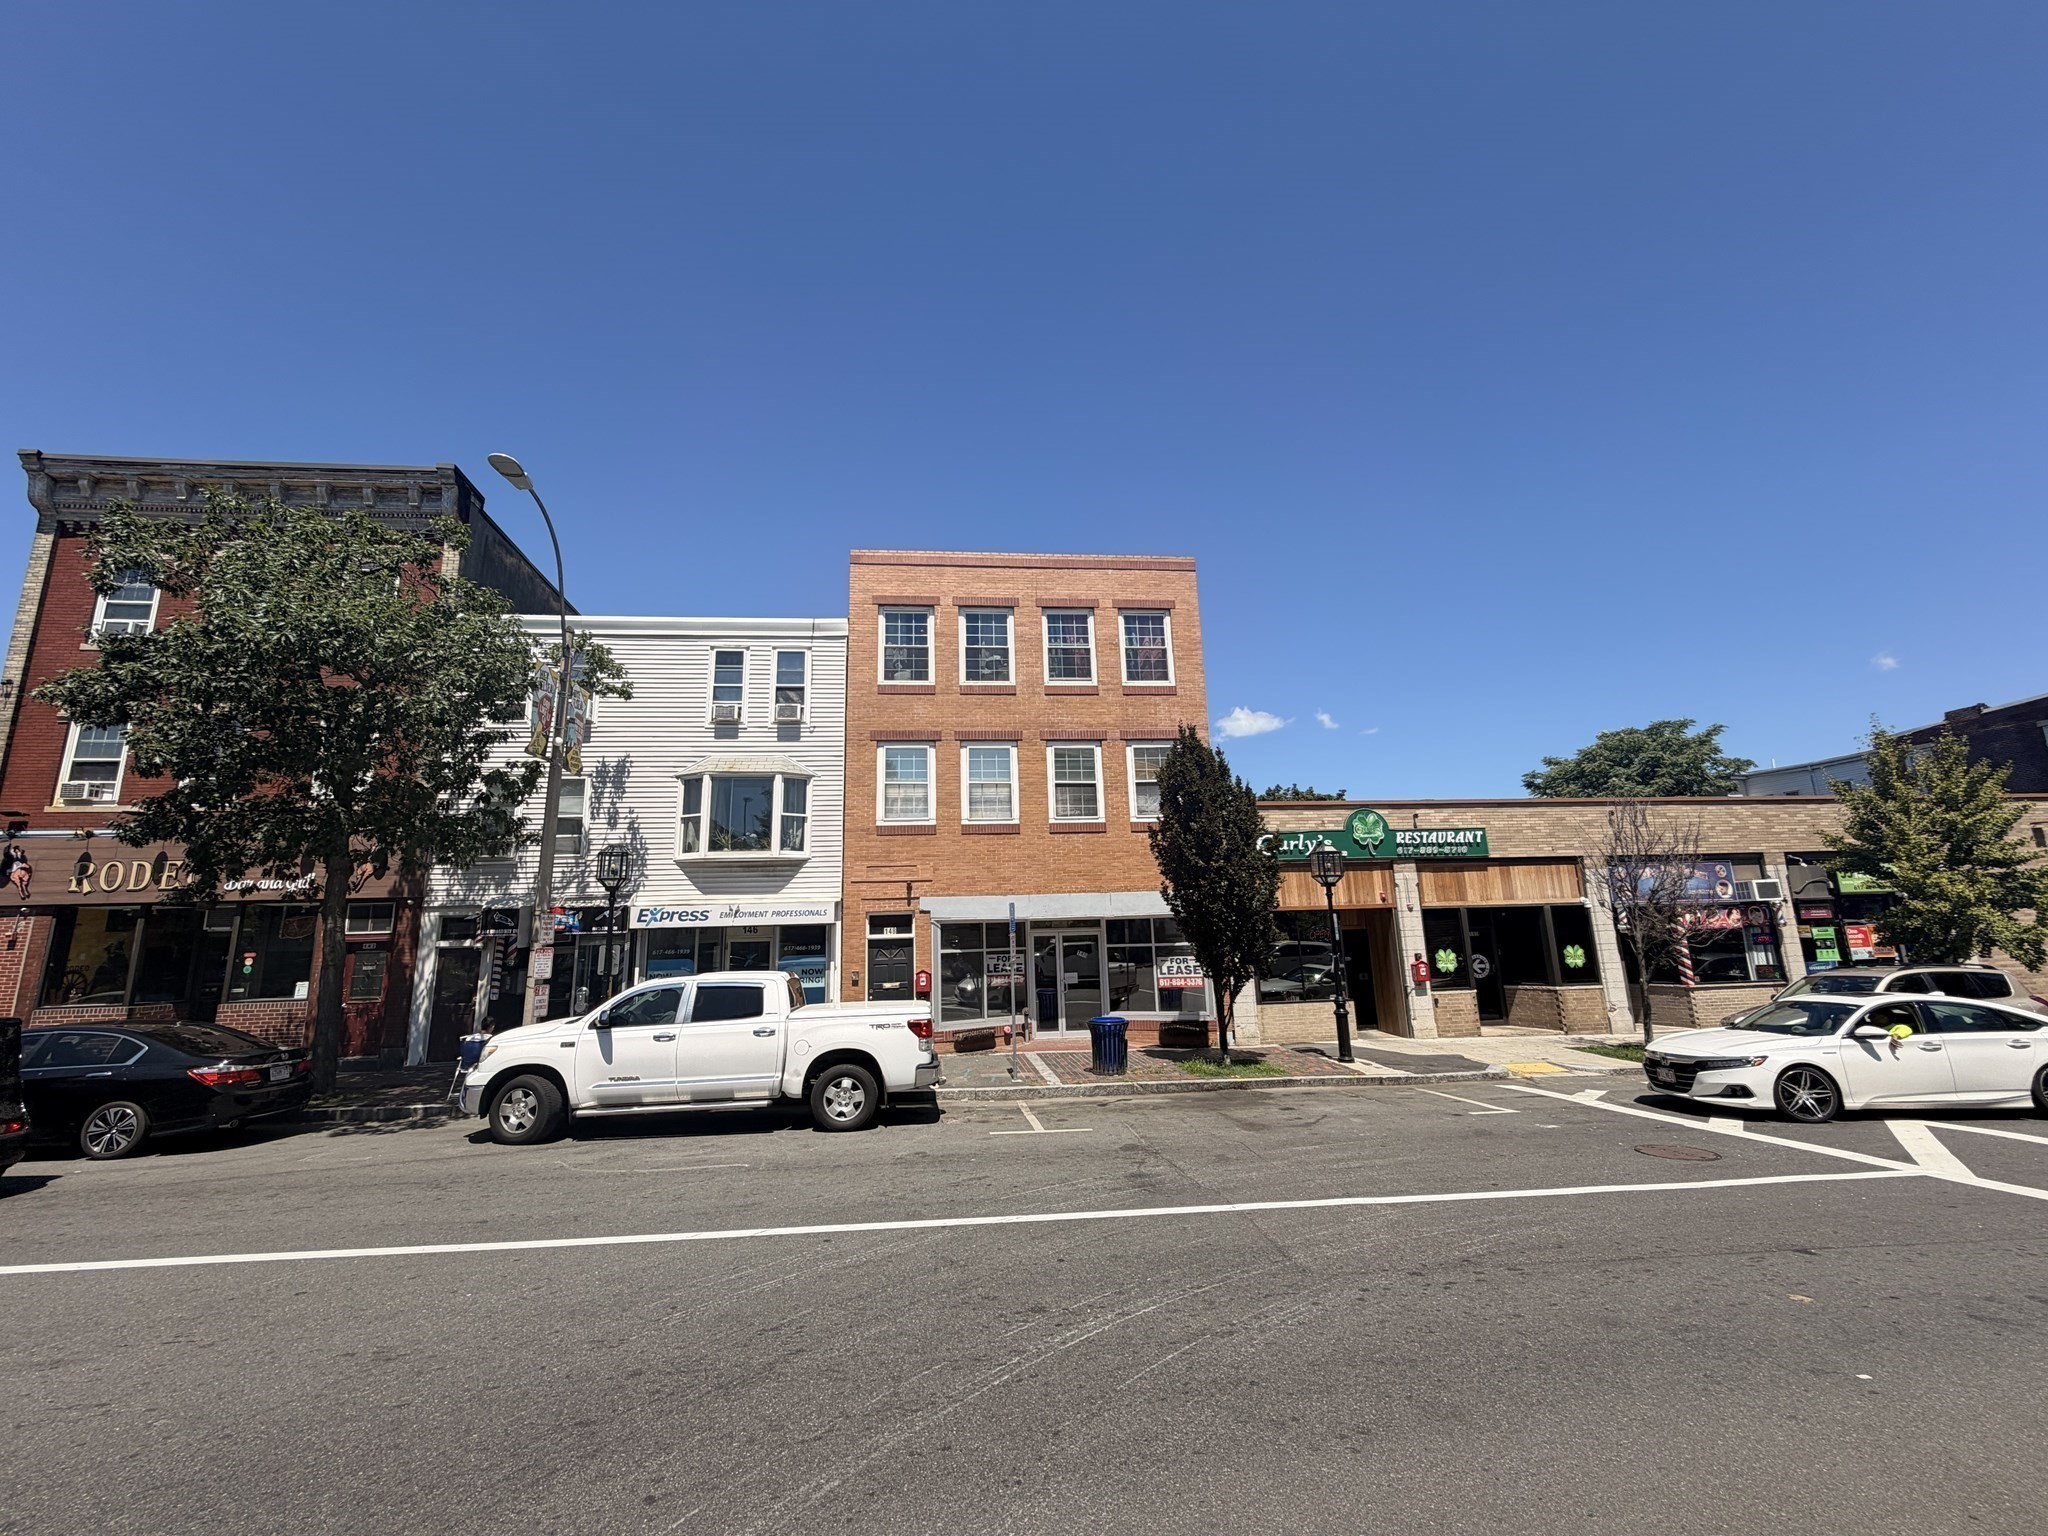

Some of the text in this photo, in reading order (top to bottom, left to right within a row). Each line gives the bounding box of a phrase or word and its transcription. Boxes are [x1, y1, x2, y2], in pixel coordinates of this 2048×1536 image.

[1396, 831, 1483, 844] RESTAURANT
[67, 860, 200, 895] RODE
[637, 907, 709, 926] Express
[771, 909, 828, 917] PROFESSIONALS
[743, 926, 758, 934] 146
[1170, 957, 1189, 965] FOR
[1159, 965, 1202, 975] LEASE
